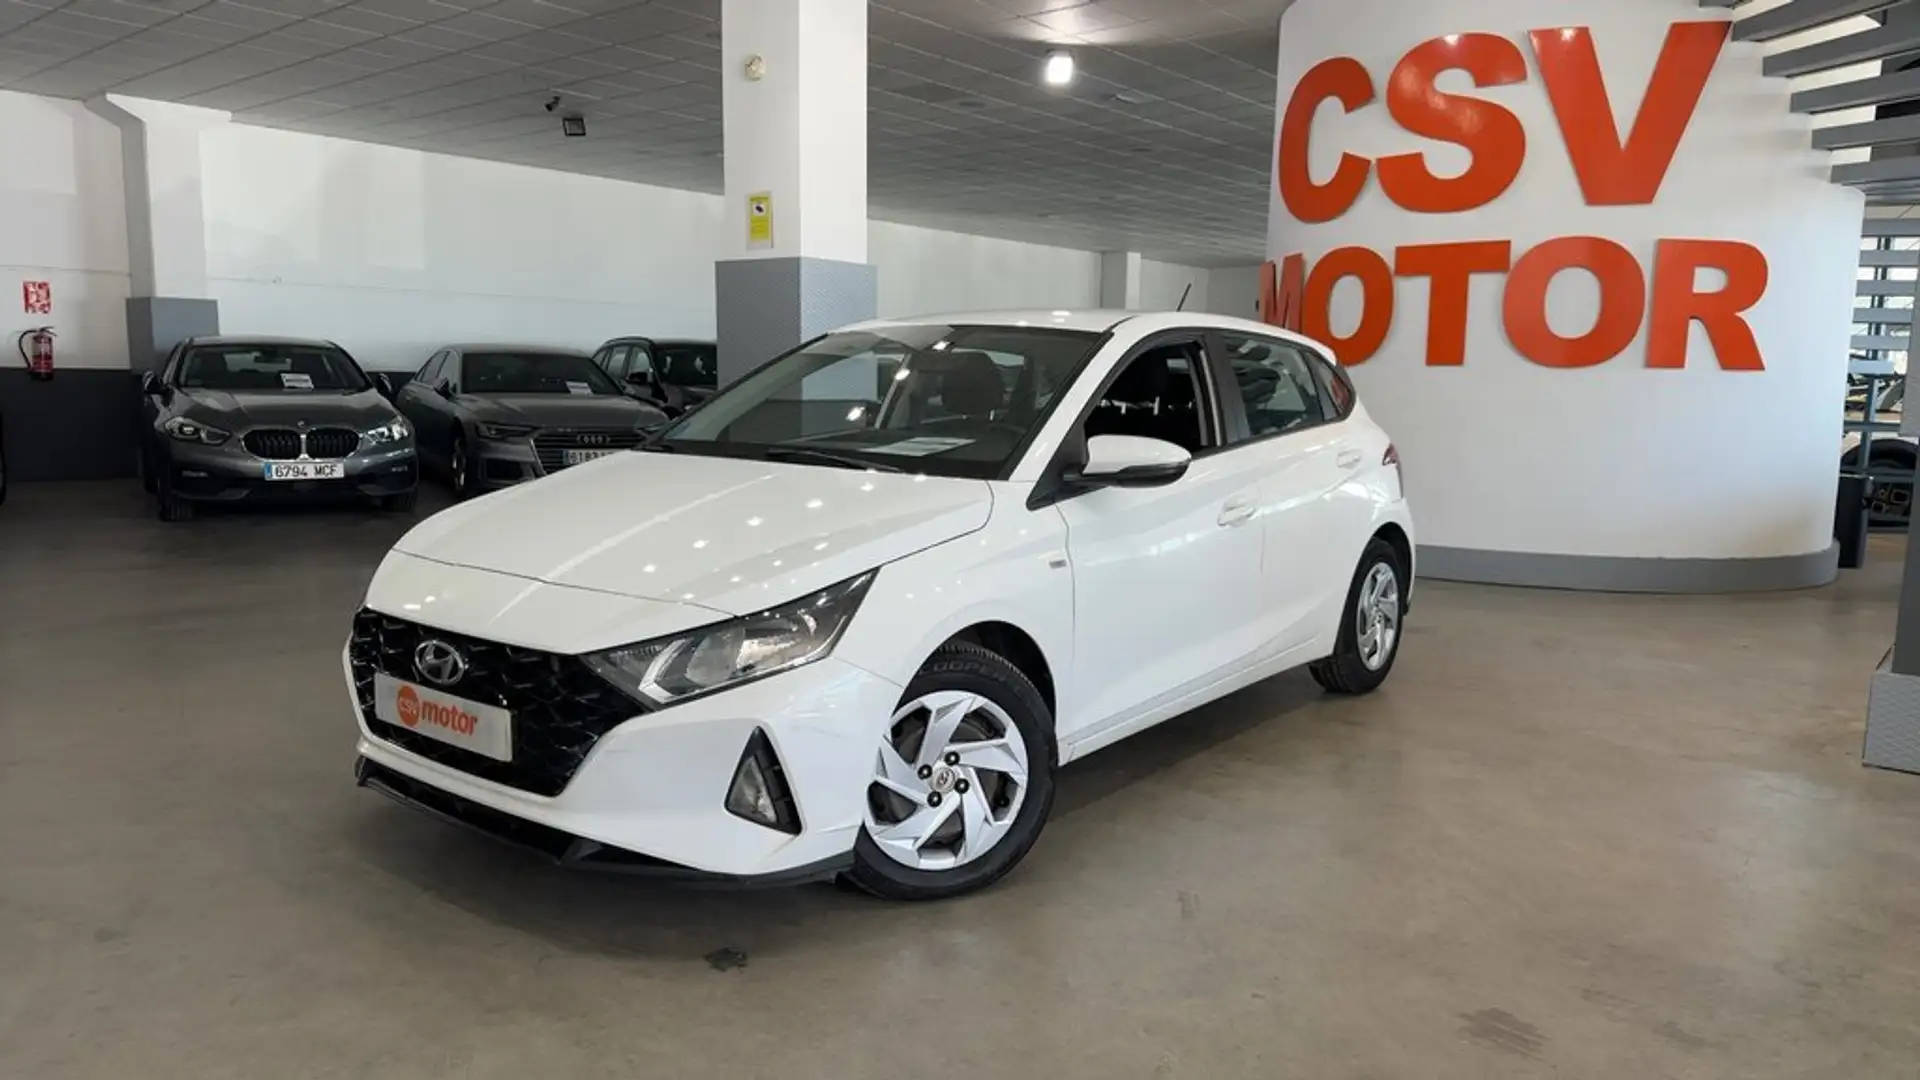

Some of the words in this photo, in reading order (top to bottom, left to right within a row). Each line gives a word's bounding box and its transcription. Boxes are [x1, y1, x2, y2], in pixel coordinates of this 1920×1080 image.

[1278, 20, 1731, 224] CSV
[1260, 236, 1768, 371] MOTOR
[275, 463, 308, 478] 6794
[422, 701, 477, 736] motor
